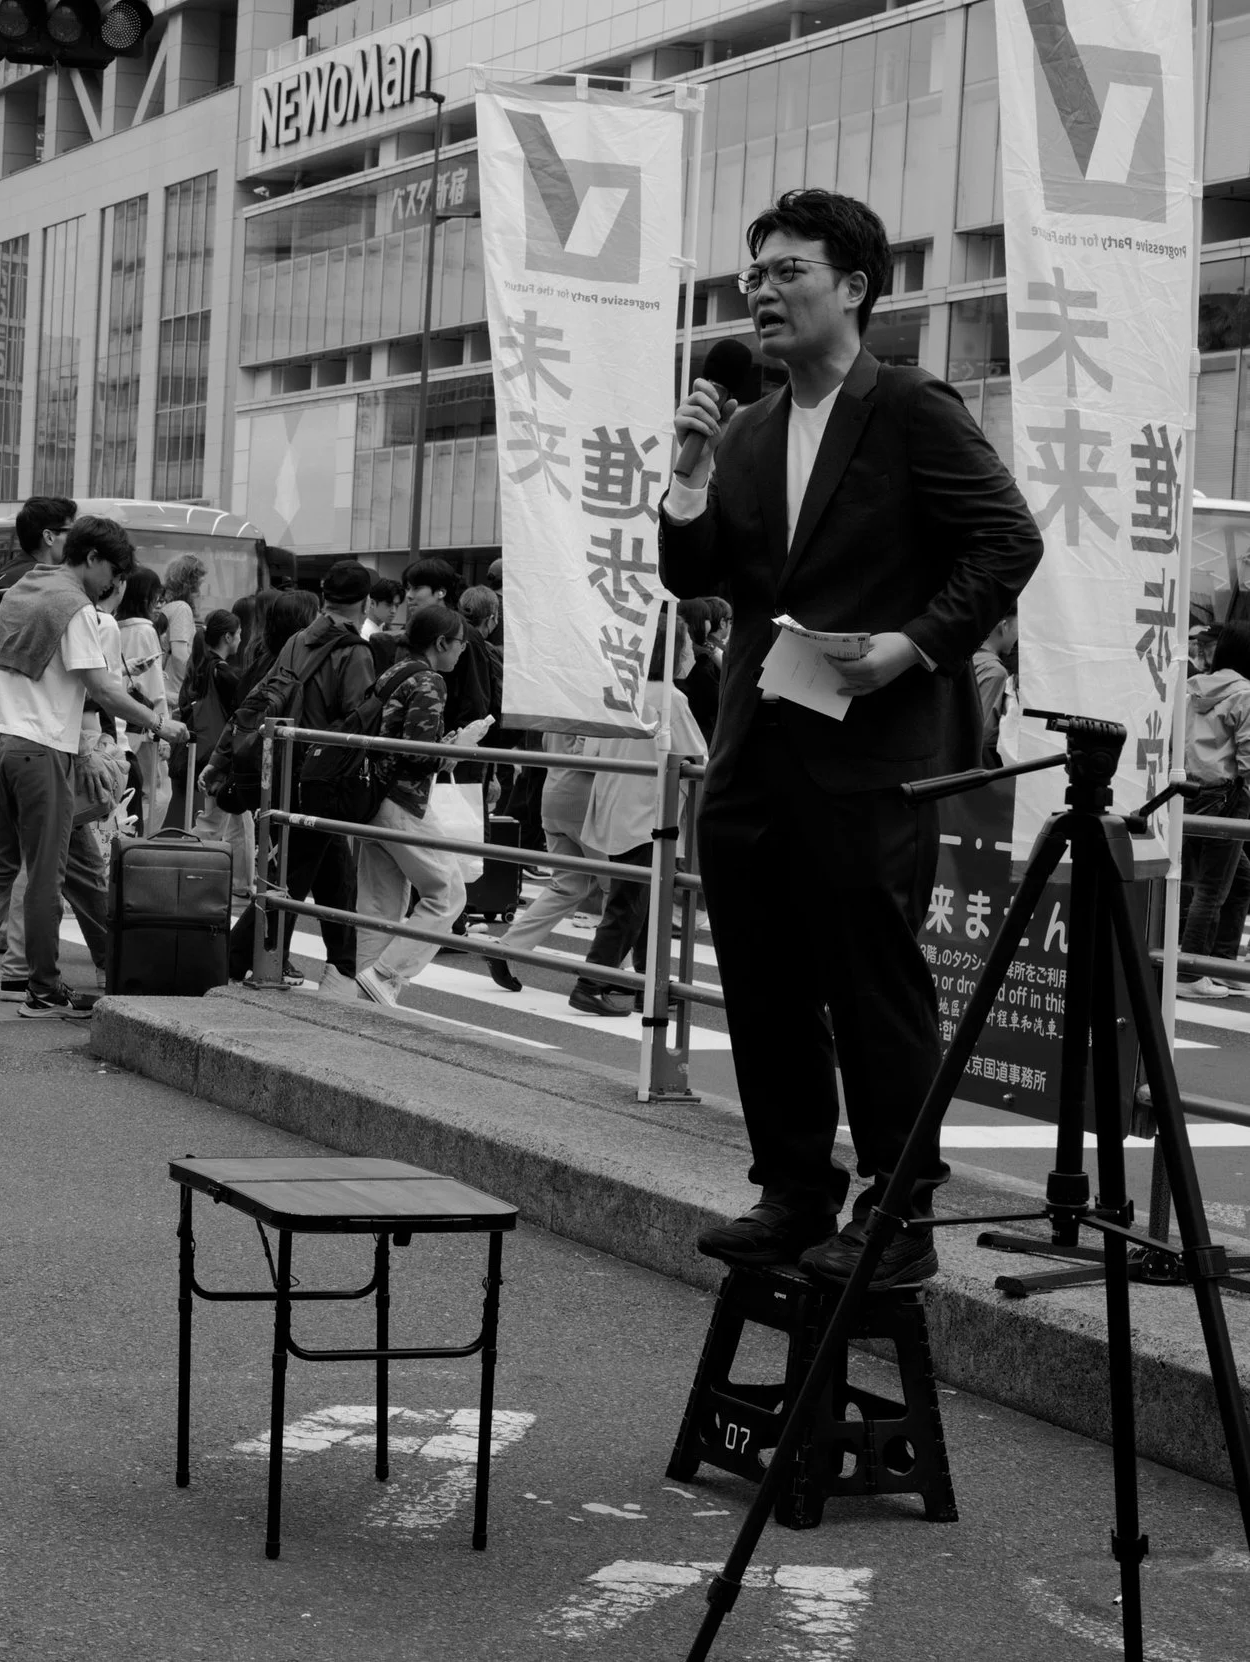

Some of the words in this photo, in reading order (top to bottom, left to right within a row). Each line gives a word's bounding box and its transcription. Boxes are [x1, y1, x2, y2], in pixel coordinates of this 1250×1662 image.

[392, 167, 469, 220] バスタ新宿
[941, 975, 954, 991] or
[1009, 985, 1028, 1006] off
[1030, 988, 1041, 1009] in
[1045, 992, 1066, 1015] this
[725, 1423, 751, 1454] 07
